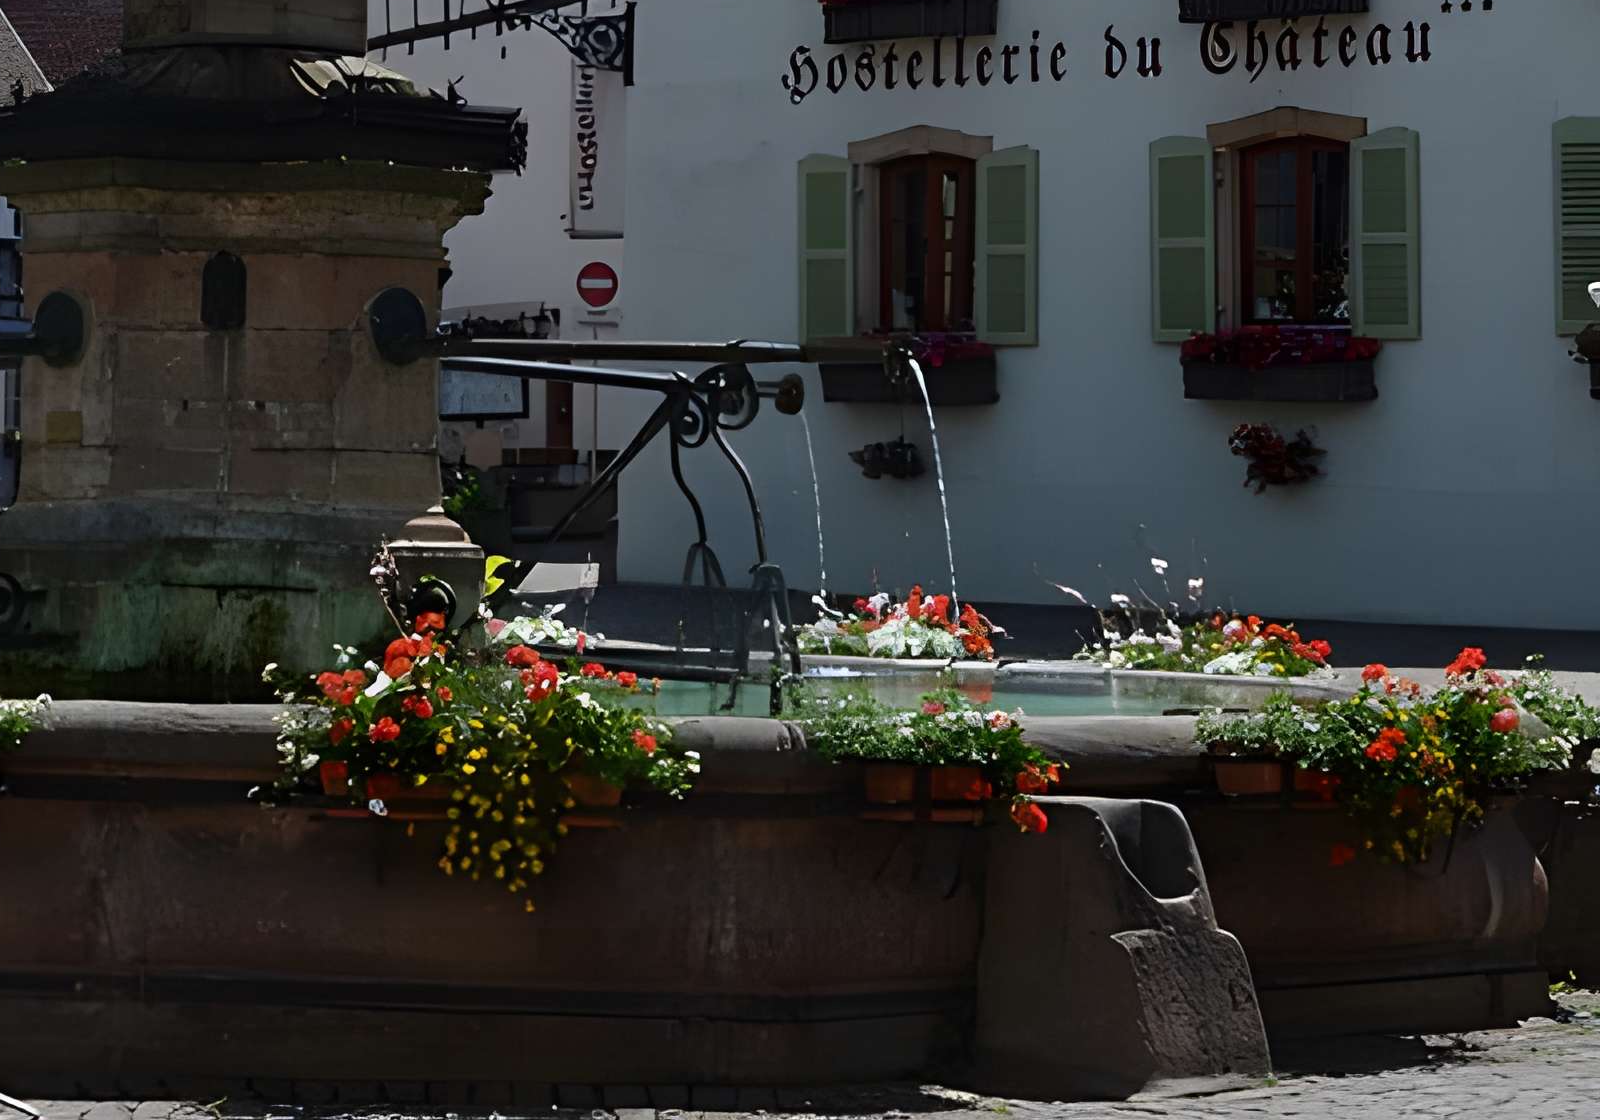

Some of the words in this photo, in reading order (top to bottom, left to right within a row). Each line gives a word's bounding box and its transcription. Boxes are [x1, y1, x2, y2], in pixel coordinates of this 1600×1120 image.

[781, 30, 1067, 104] Hostellerie
[1104, 24, 1163, 79] du
[1199, 15, 1432, 83] Château
